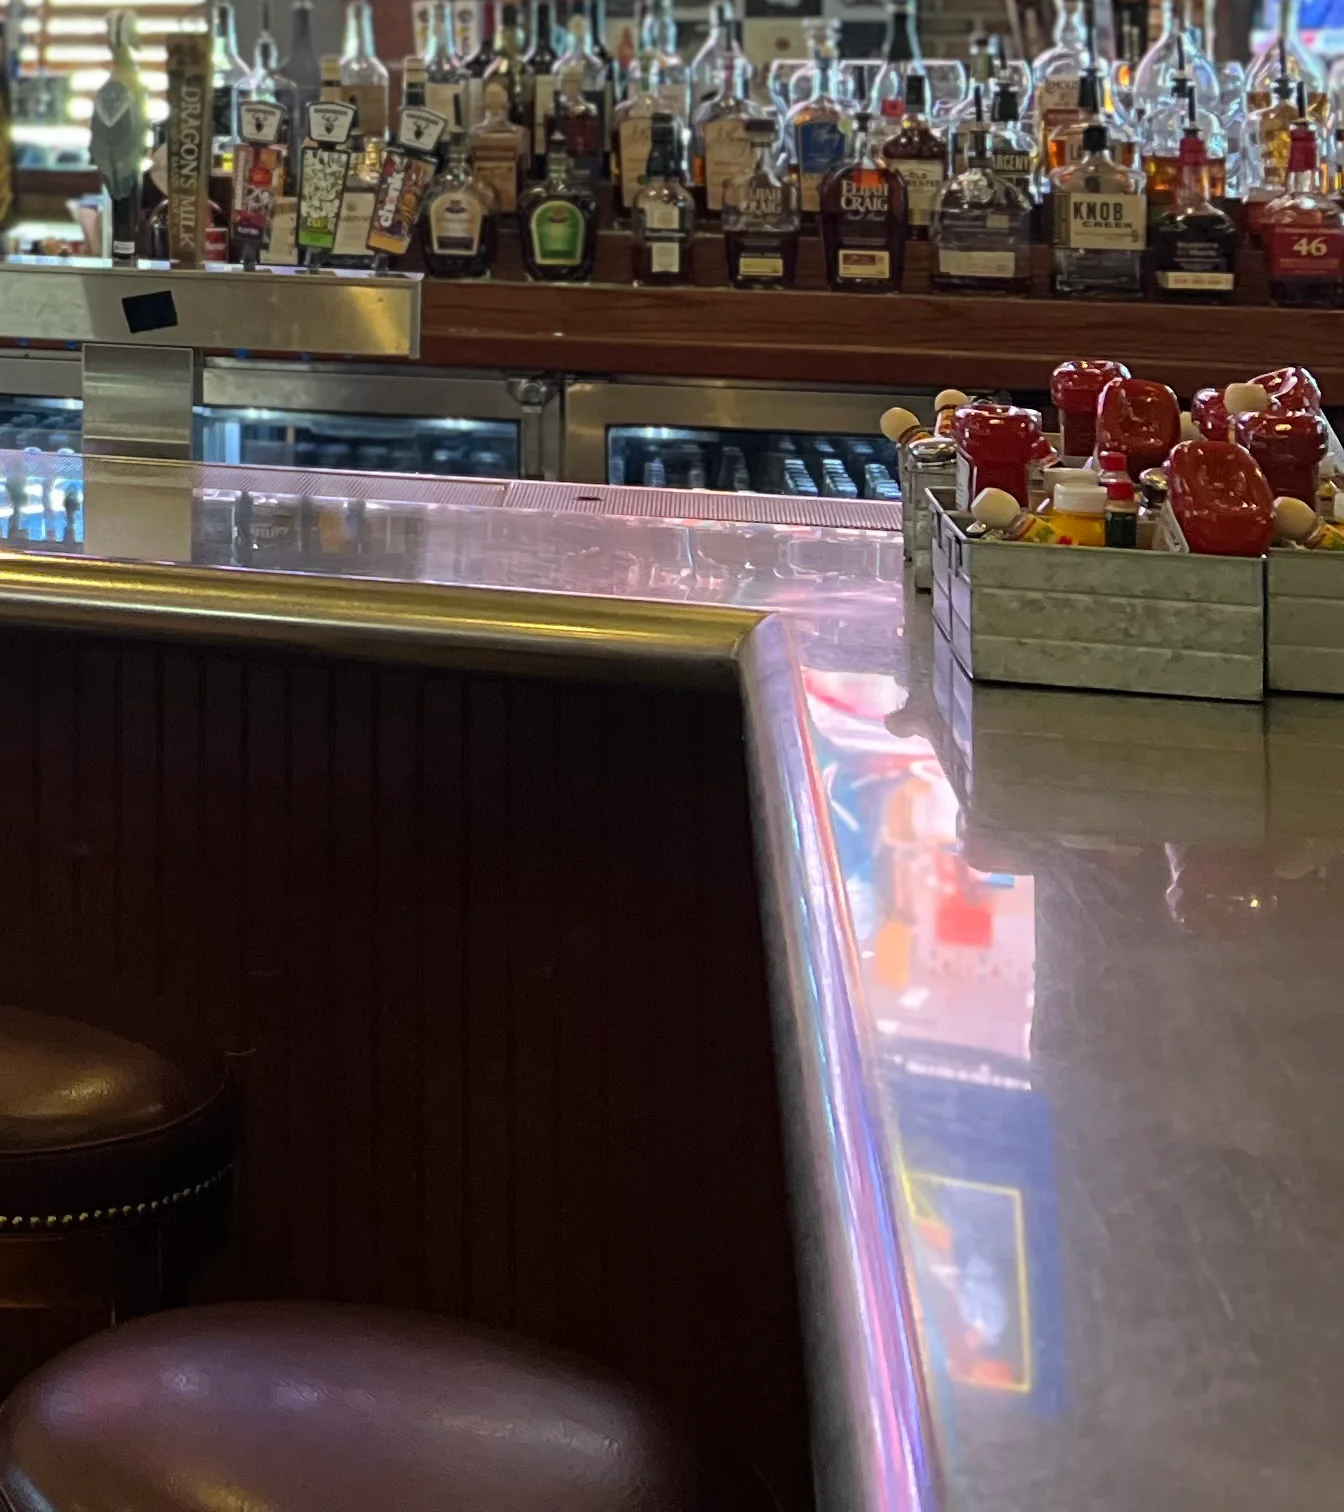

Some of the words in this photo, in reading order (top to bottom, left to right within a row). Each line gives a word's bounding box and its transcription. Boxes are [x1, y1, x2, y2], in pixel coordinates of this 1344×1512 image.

[841, 180, 889, 198] ELIJAH
[840, 194, 889, 213] CRAIG
[1074, 201, 1123, 220] KNOB
[179, 194, 197, 249] MILK
[1293, 237, 1328, 256] 46
